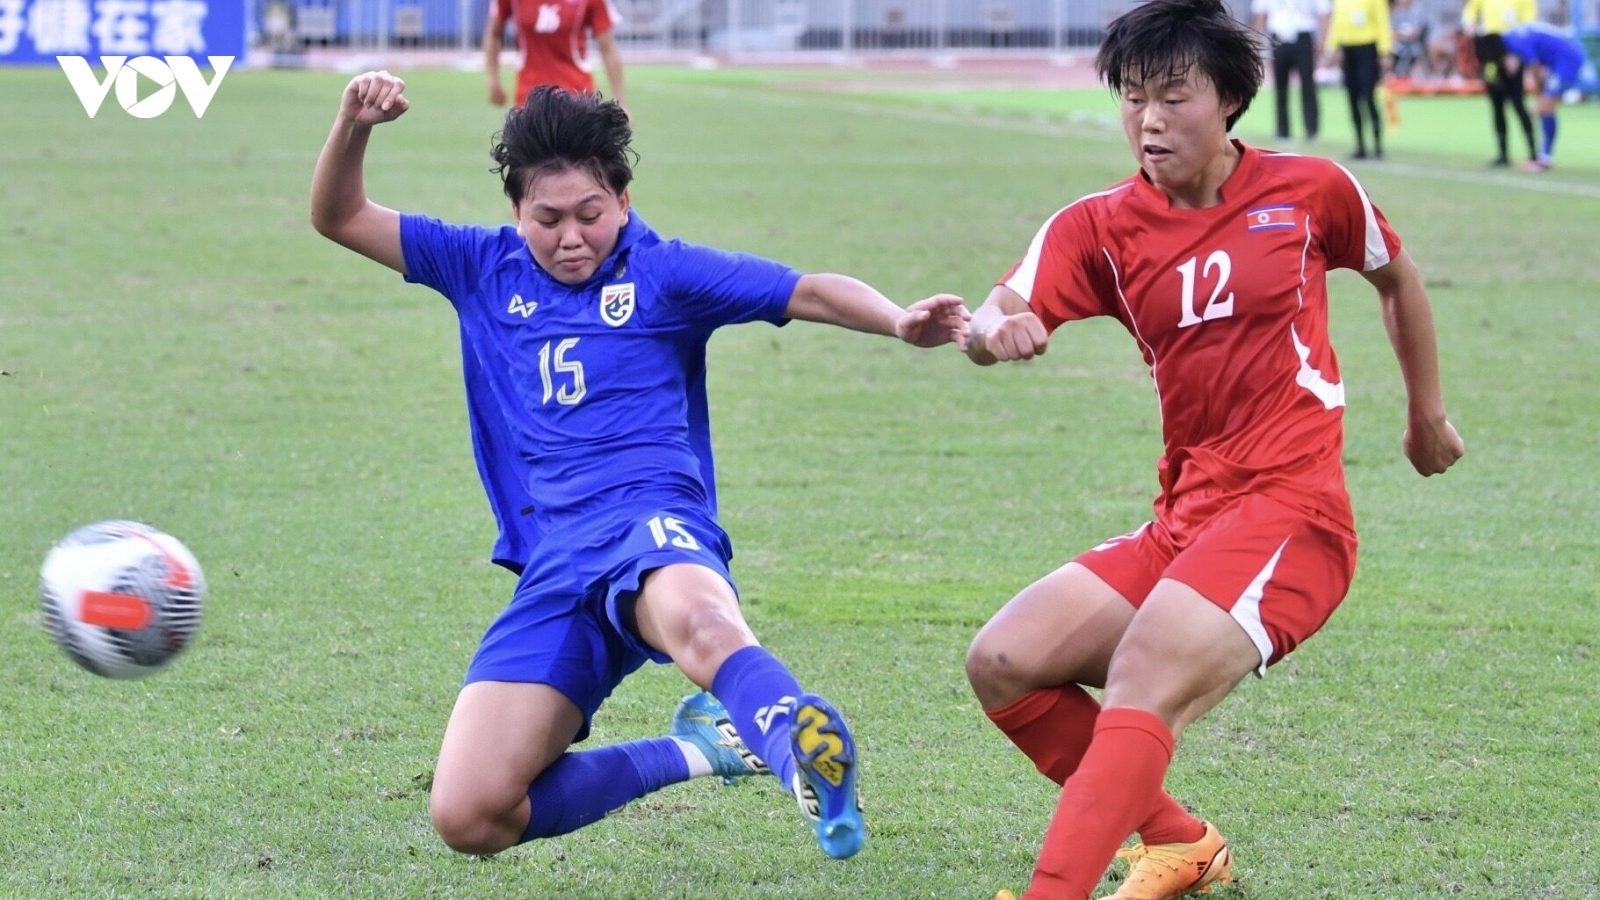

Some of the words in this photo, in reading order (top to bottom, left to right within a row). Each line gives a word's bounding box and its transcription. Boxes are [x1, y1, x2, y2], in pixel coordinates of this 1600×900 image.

[1176, 250, 1235, 328] 12
[538, 337, 587, 406] 15
[646, 516, 701, 551] 15
